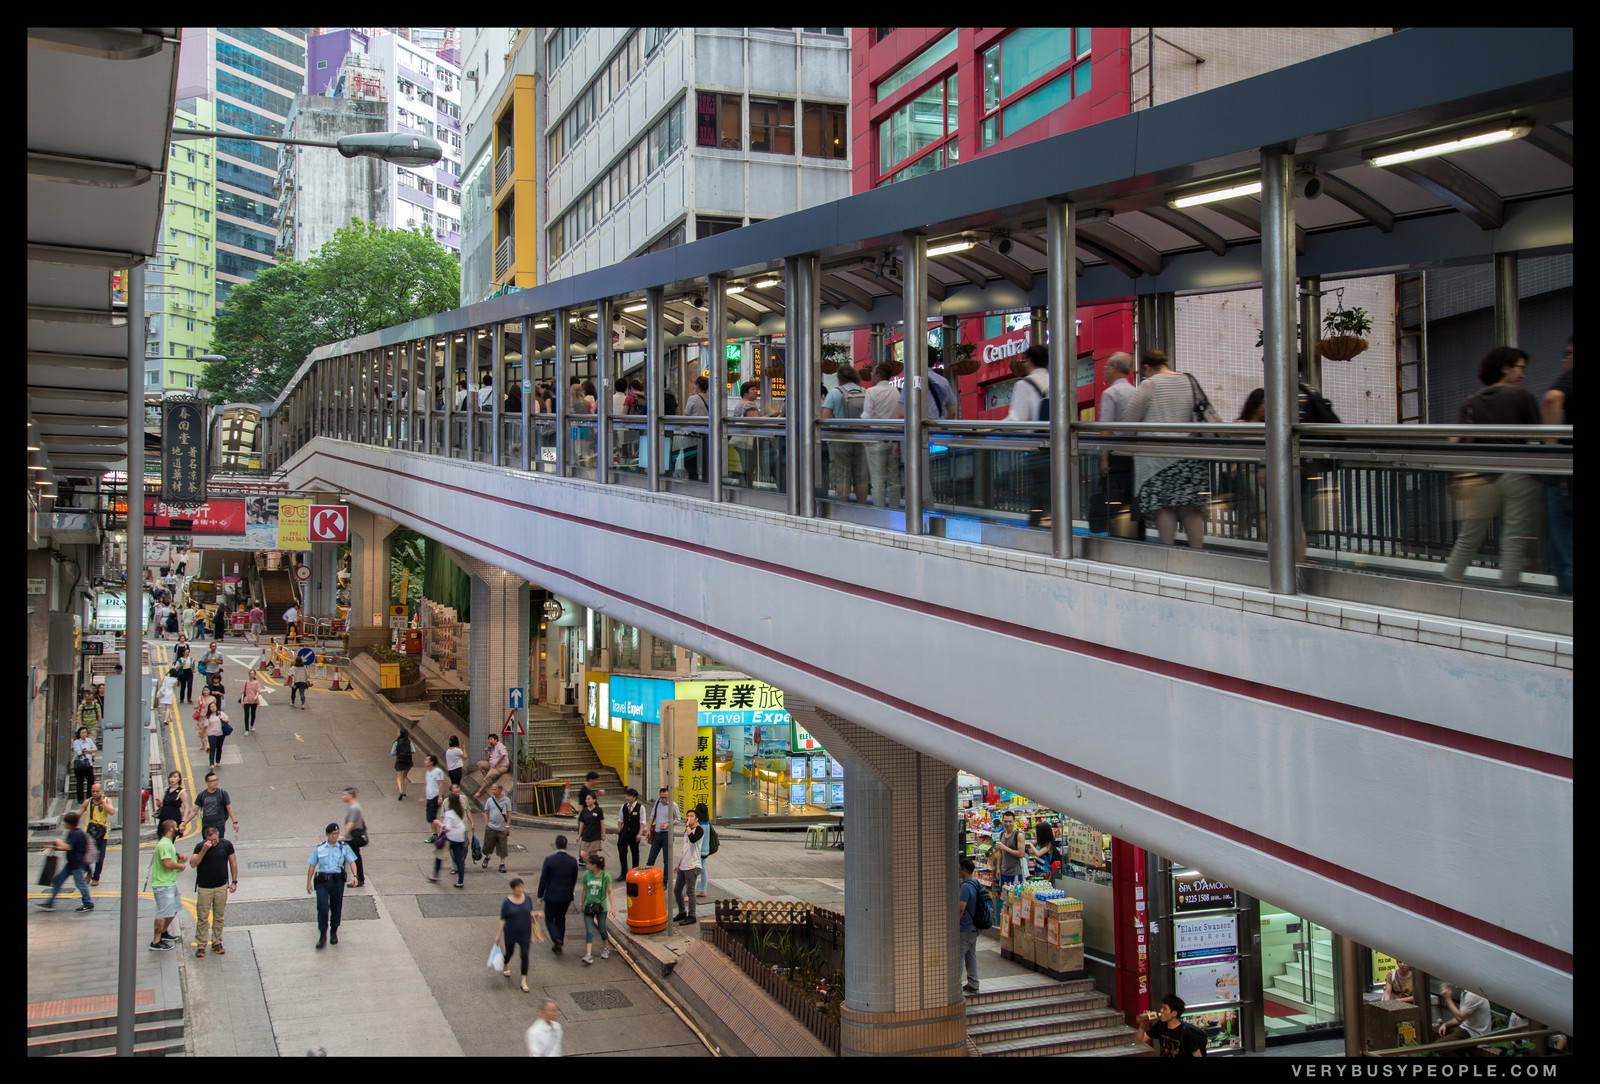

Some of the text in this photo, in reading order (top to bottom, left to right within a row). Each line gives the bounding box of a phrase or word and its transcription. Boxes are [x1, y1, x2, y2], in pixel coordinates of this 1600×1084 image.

[983, 330, 1030, 364] Central
[319, 511, 343, 538] K
[700, 683, 783, 709] 專業旅
[612, 700, 644, 716] Travel Expert
[703, 711, 791, 725] Travel Expe
[1180, 922, 1232, 933] Elaine Swanson
[1180, 932, 1232, 943] Hong Kong
